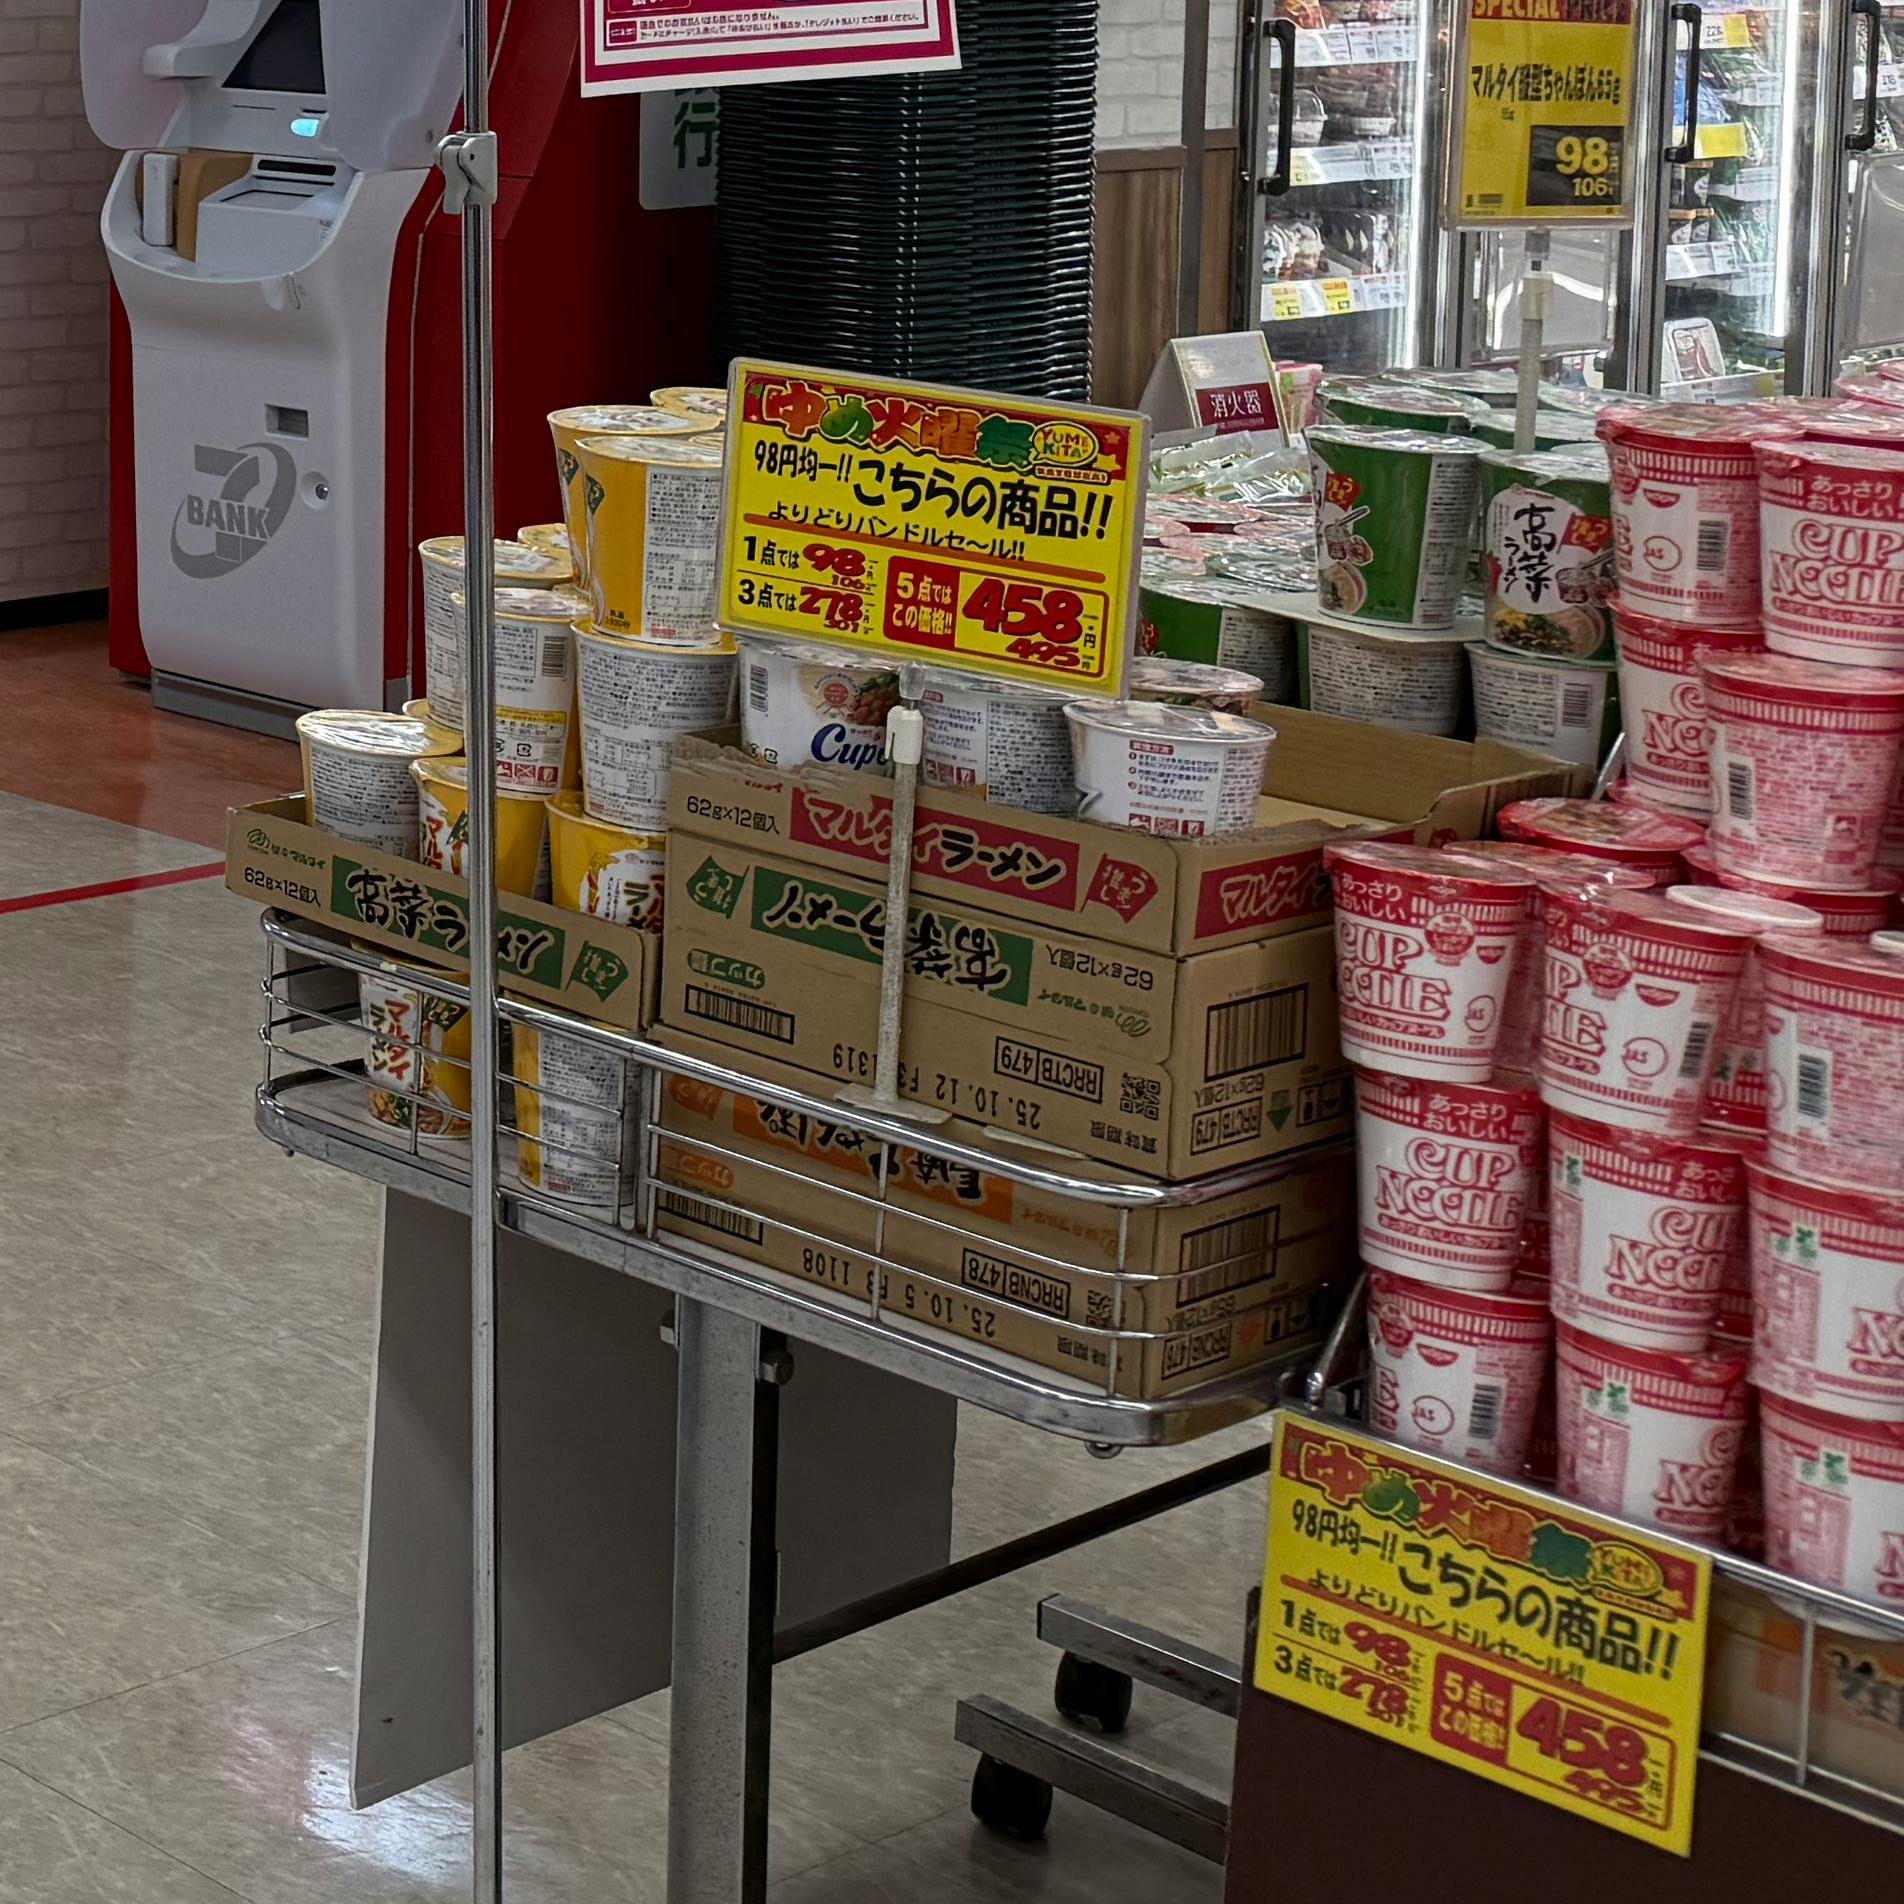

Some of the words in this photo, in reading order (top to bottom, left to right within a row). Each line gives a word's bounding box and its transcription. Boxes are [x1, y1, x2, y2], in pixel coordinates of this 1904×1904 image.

[1555, 135, 1609, 176] 98
[1207, 388, 1265, 420] 消火器
[853, 457, 1114, 541] こちらの商品!!
[1810, 475, 1893, 496] あっさり
[186, 493, 272, 540] BANK
[743, 535, 800, 570] 1点では
[802, 542, 868, 577] 98
[1792, 518, 1904, 566] CUP
[737, 578, 798, 613] 3点では
[798, 586, 865, 623] 278
[891, 602, 953, 636] この価格!!
[895, 572, 953, 605] 5点では
[961, 576, 1085, 646] 458
[685, 795, 781, 836] 62g×12個入
[806, 794, 1068, 891] マルタイラーメン
[1341, 872, 1403, 902] あっさり
[344, 867, 549, 975] 高菜ラメン
[1337, 919, 1424, 975] CUP
[1000, 1041, 1035, 1074] 479
[1040, 1051, 1099, 1095] RRCTB
[1429, 1094, 1509, 1122] あっさり
[1088, 1120, 1159, 1154] 賞味期限
[1405, 1137, 1516, 1190] CUP
[801, 1246, 852, 1287] 1108
[966, 1253, 1001, 1288] 478
[1006, 1272, 1066, 1313] RRCNB
[1397, 1541, 1682, 1682] こちらの商品!!
[1280, 1601, 1342, 1646] 1点では
[1343, 1621, 1413, 1669] 98
[1274, 1644, 1338, 1693] 3点では
[1338, 1666, 1410, 1719] 278
[1516, 1696, 1649, 1790] 458
